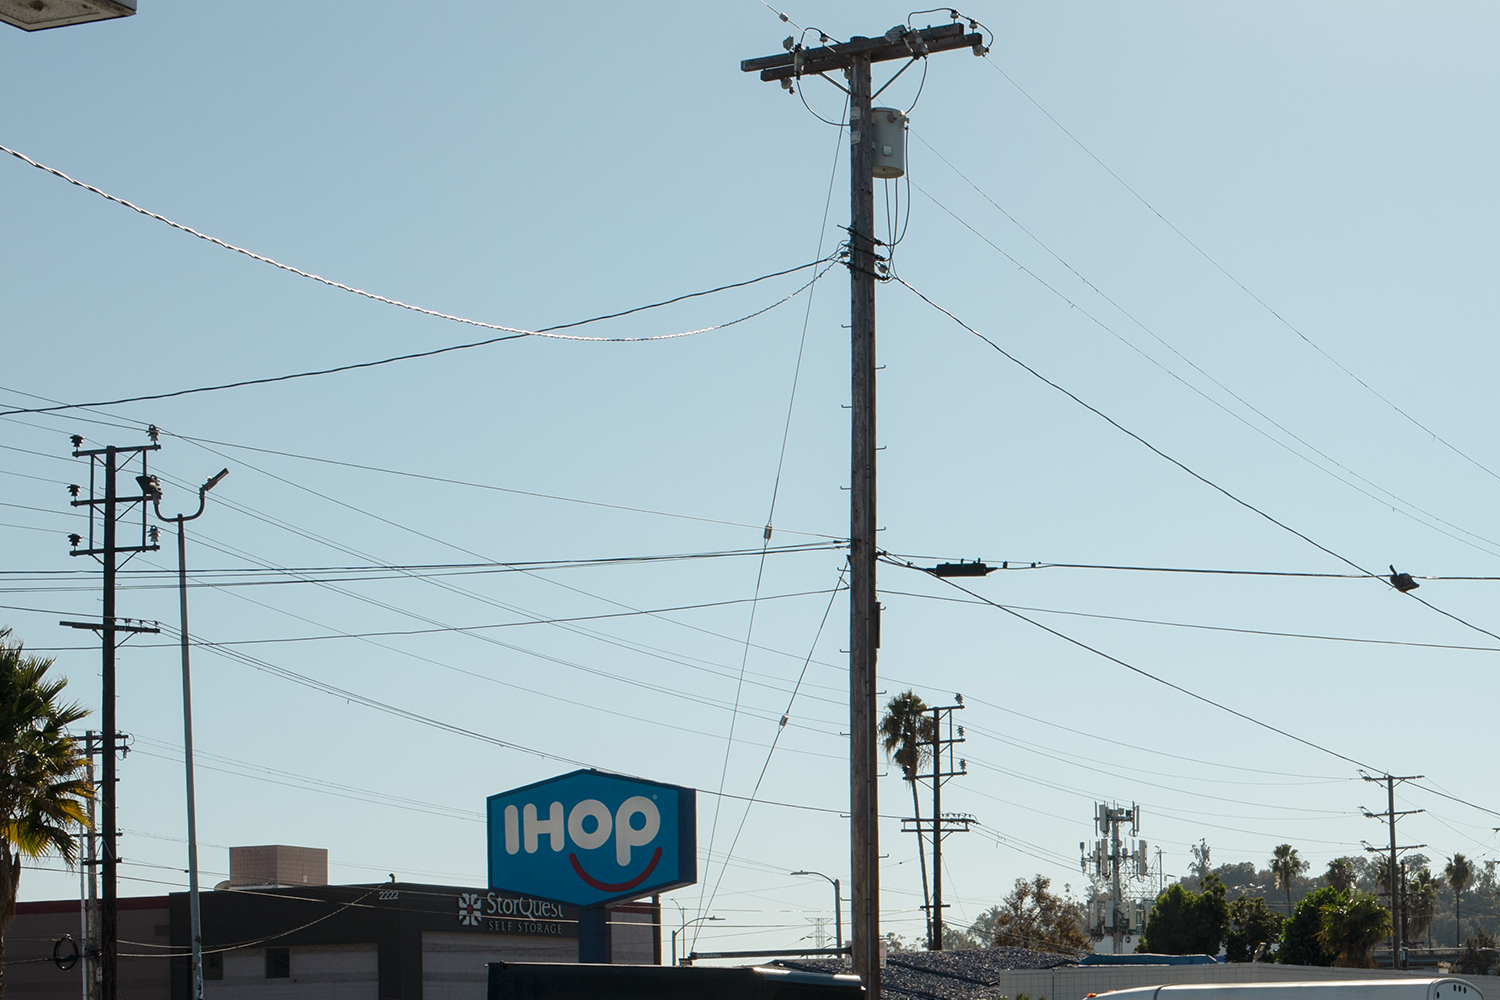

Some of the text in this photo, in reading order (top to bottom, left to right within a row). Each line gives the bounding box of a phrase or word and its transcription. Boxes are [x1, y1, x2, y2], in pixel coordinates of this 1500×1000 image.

[504, 796, 661, 867] IHOP
[379, 890, 399, 900] 2222
[488, 920, 562, 934] SELF STORAGE
